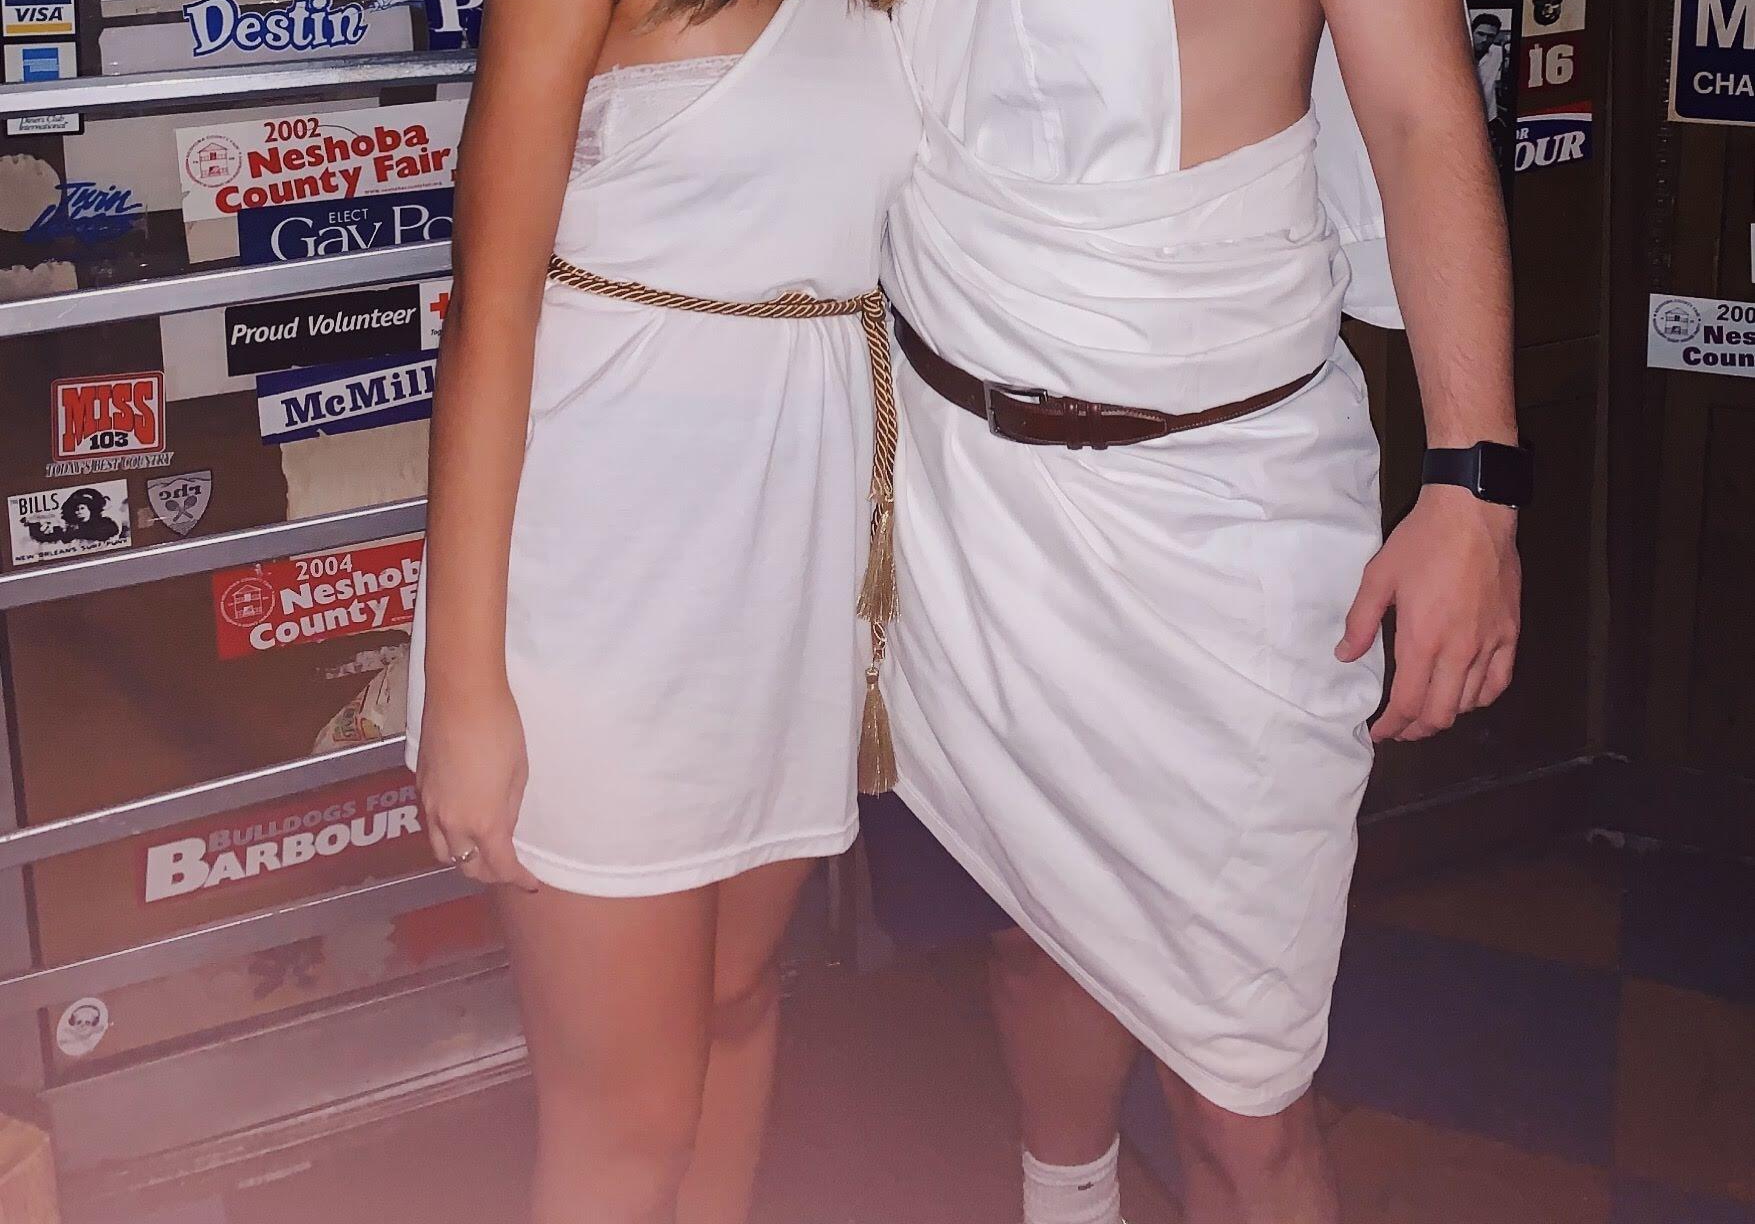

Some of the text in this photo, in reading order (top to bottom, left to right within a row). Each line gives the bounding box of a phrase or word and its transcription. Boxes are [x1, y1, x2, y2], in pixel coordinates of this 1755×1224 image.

[15, 7, 64, 22] VISA
[1528, 44, 1574, 88] 16
[264, 119, 320, 143] 2002
[248, 126, 429, 179] Neshoba
[216, 147, 451, 214] County Fair
[329, 209, 368, 224] ELECT
[231, 306, 416, 346] Proud Volunteer
[61, 381, 156, 452] MISS
[89, 431, 129, 449] 103
[92, 457, 121, 474] BEST
[121, 452, 174, 470] COUNTRY
[18, 493, 59, 515] BILLS
[295, 554, 353, 581] 2004
[249, 597, 391, 651] County
[207, 786, 417, 853] BULLDOGS FOR
[145, 805, 422, 903] BARBOUR
